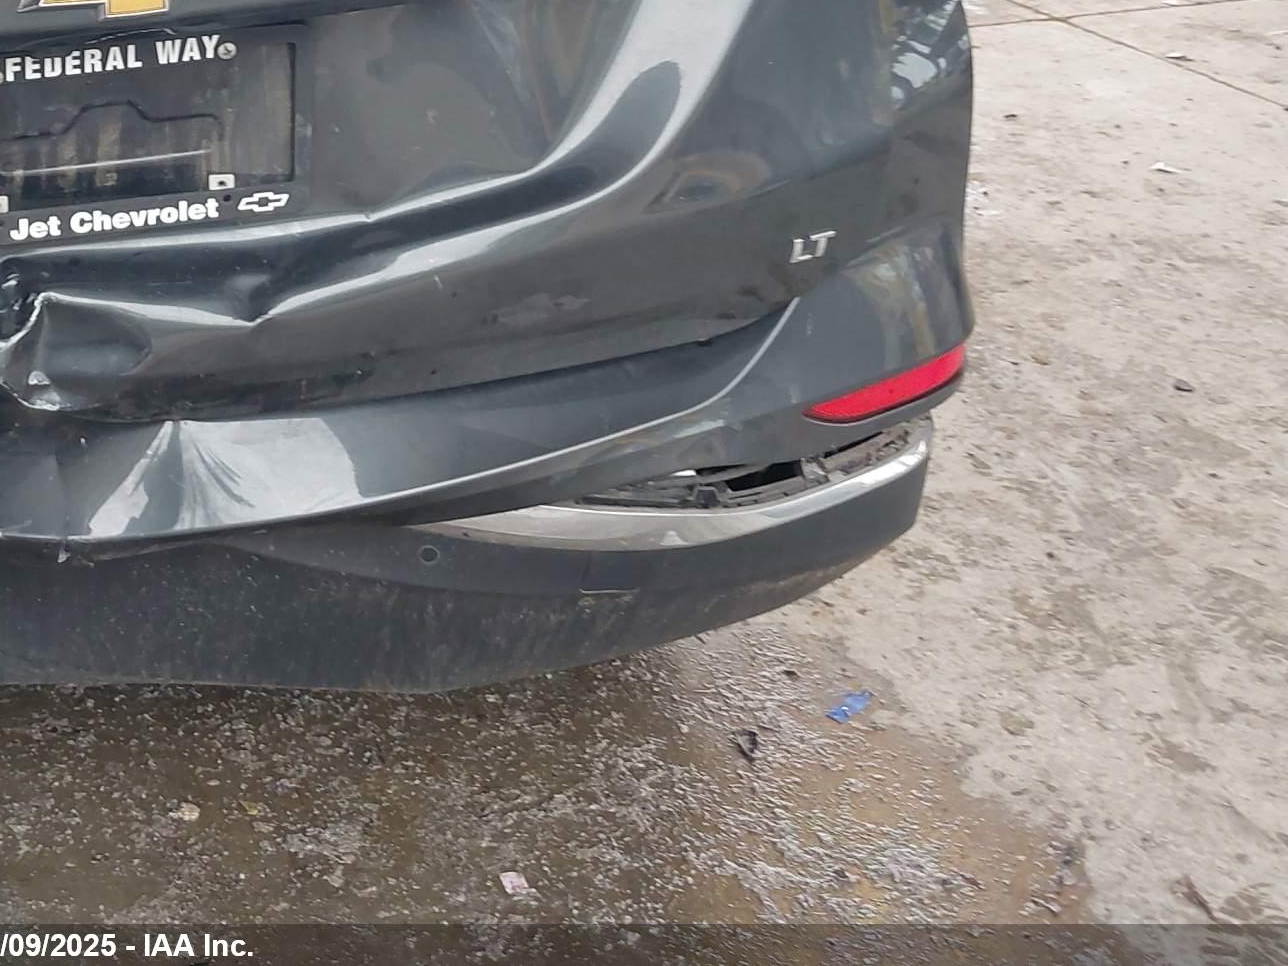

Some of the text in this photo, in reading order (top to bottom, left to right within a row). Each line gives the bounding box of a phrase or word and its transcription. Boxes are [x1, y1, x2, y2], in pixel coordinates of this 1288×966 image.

[4, 35, 221, 83] FEDERAL WAY
[9, 198, 220, 241] Jet Chevrolet
[789, 230, 838, 264] LT
